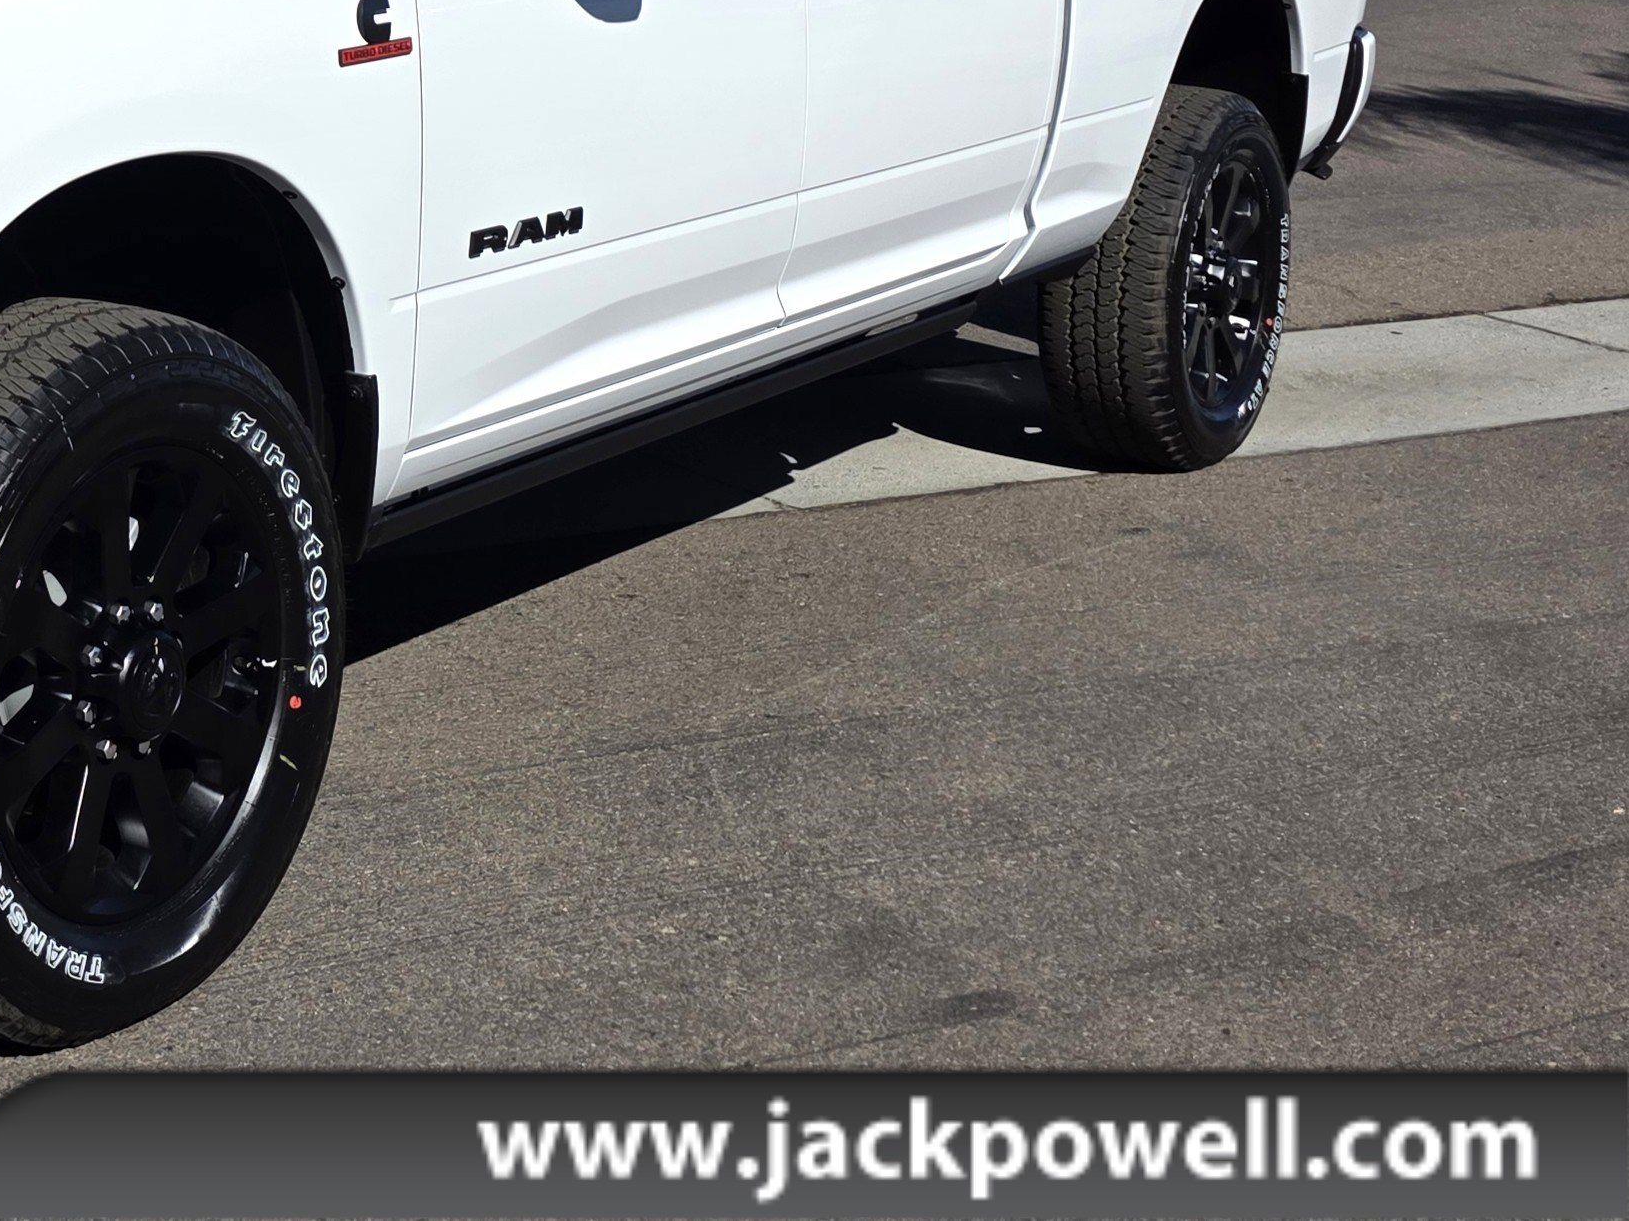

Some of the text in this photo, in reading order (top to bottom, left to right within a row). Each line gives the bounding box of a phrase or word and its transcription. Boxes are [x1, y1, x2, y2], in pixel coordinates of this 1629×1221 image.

[343, 40, 410, 62] TURBO DIESEL
[468, 206, 584, 260] RAM
[230, 410, 330, 689] Firestone
